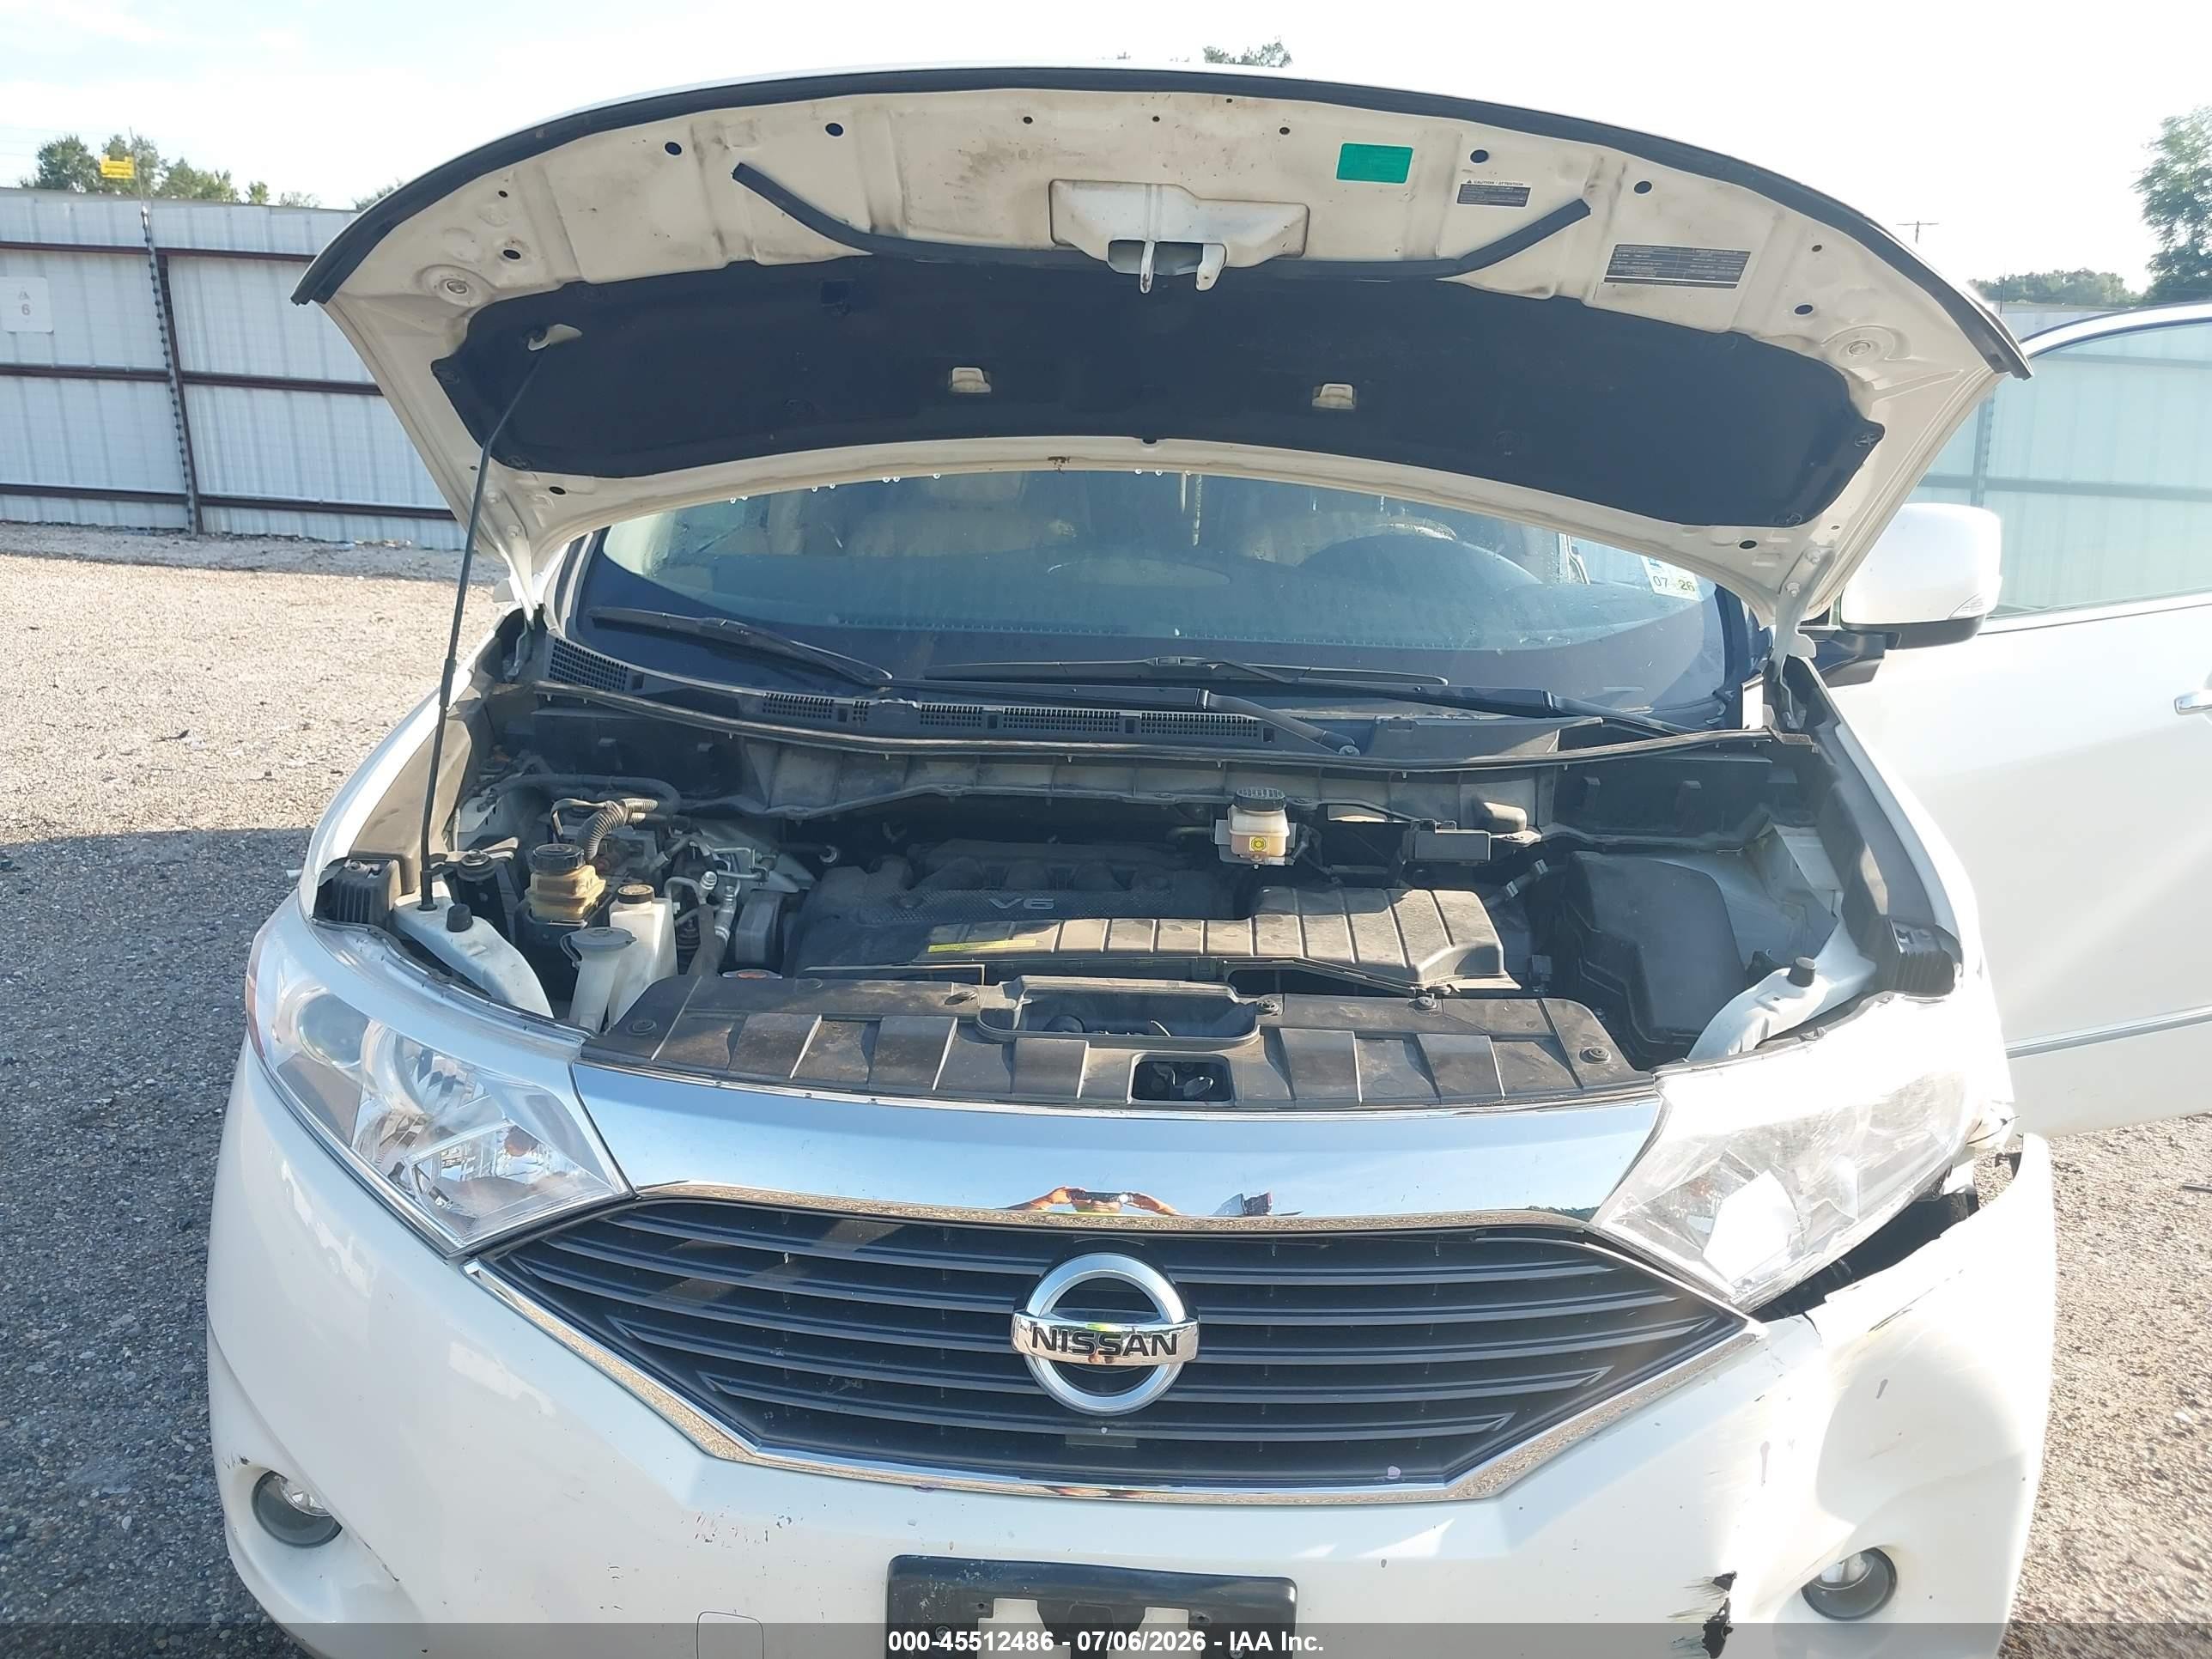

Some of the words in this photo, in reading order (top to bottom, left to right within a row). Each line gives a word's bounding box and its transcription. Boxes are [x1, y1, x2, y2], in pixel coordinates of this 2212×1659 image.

[21, 303, 31, 316] 6
[1652, 575, 1668, 588] 07
[1678, 579, 1696, 592] 26
[988, 897, 1055, 910] V6
[1031, 1325, 1178, 1358] NISSAN
